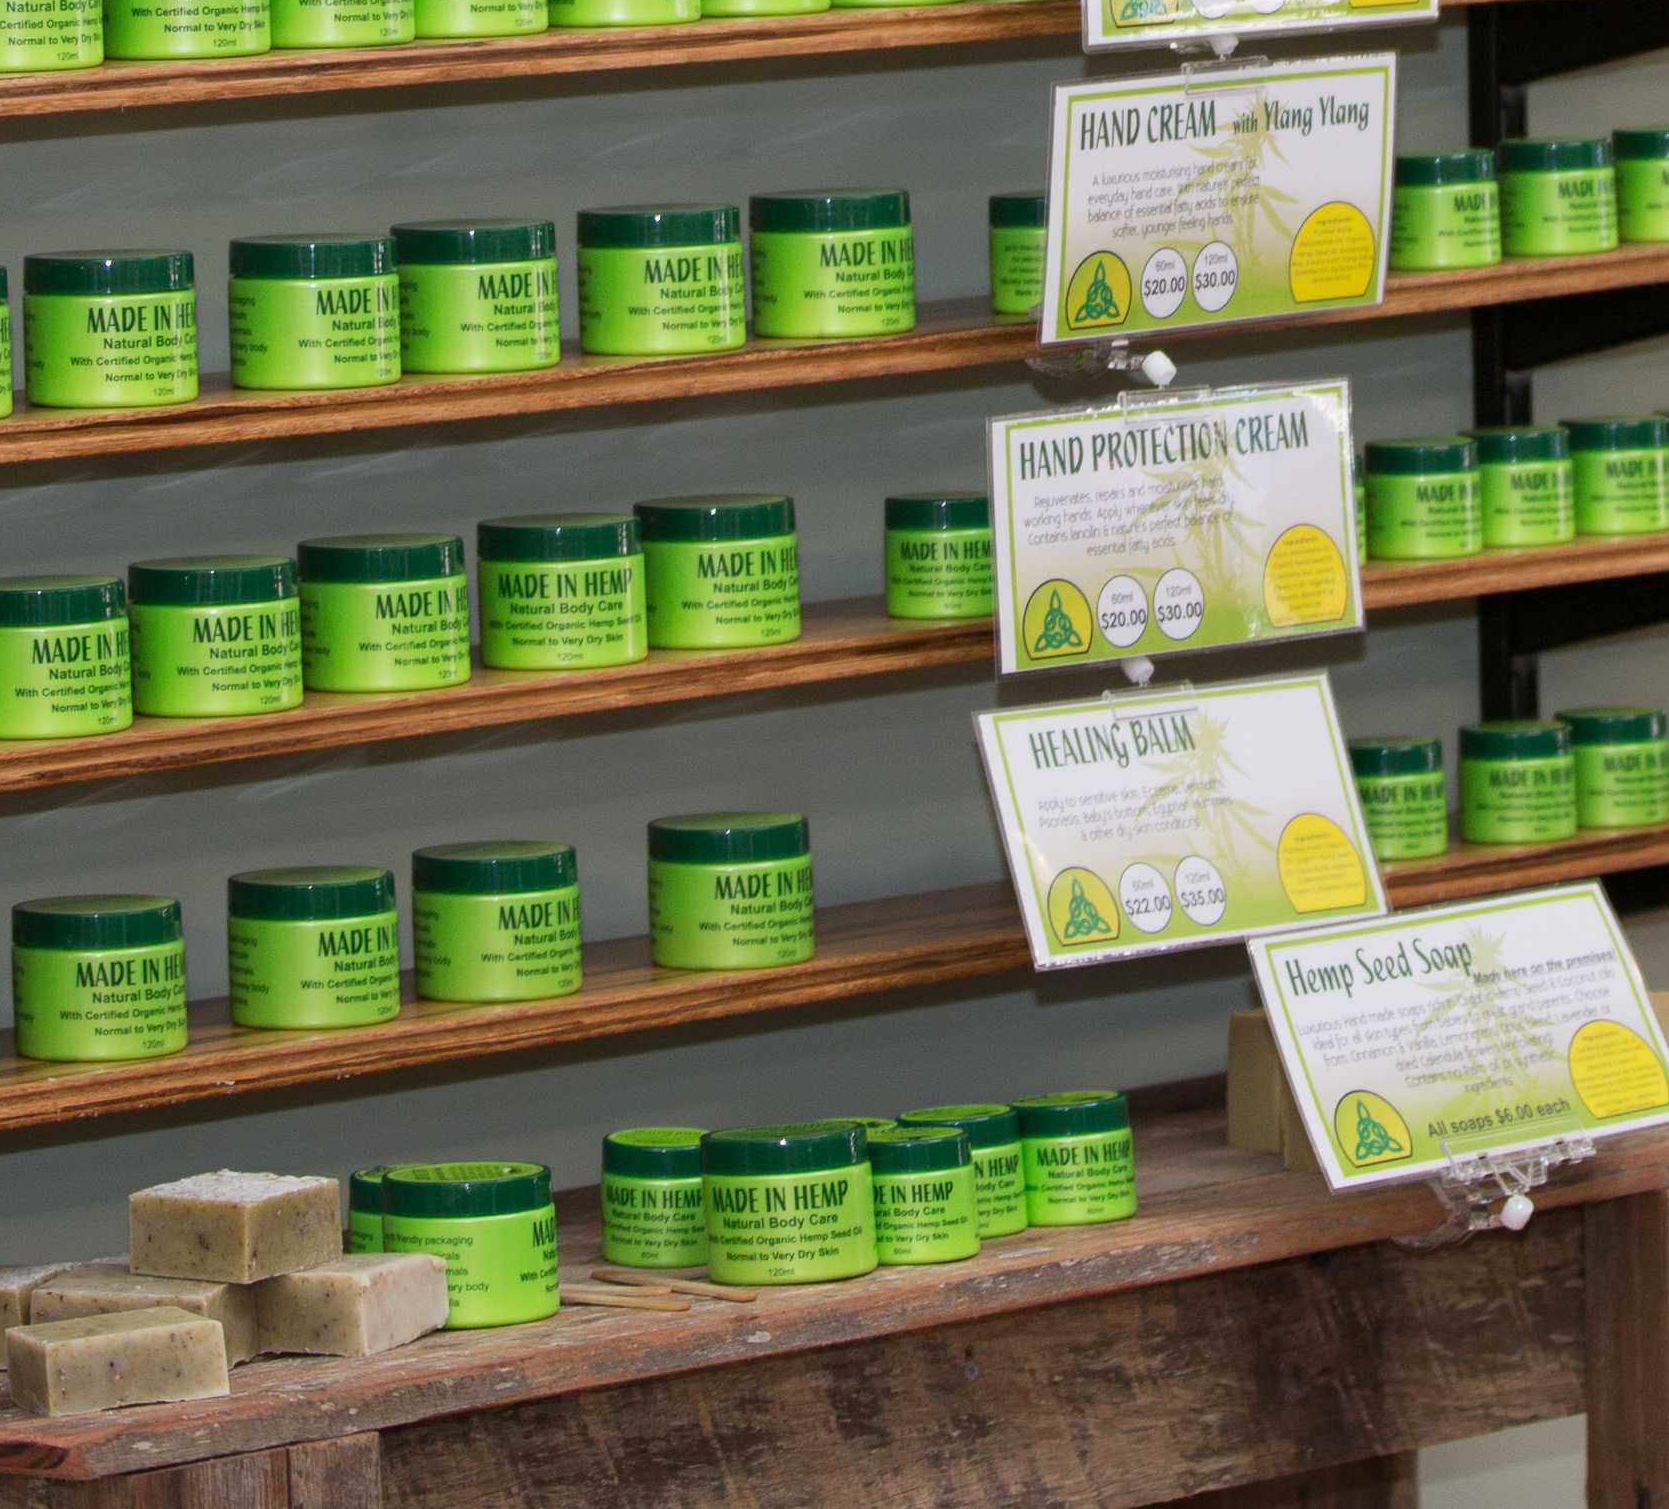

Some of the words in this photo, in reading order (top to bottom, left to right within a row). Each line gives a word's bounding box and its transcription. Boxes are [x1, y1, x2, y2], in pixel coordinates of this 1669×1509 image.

[1080, 108, 1140, 150] HAND
[1147, 101, 1215, 141] CREAM
[1232, 116, 1258, 135] with
[1263, 102, 1312, 136] Ylang
[1319, 97, 1369, 130] Ylang
[1144, 277, 1185, 296] $20.00
[1195, 272, 1235, 290] $30.00
[1020, 437, 1083, 480] HAND
[1092, 420, 1228, 471] PROTECTION
[1235, 412, 1308, 454] CREAM
[498, 573, 549, 599] MADE
[557, 574, 577, 598] IN
[585, 568, 632, 596] HEMP
[510, 603, 555, 614] Natural
[560, 602, 594, 615] Body
[598, 600, 623, 611] Care
[1101, 609, 1147, 629] $20.00
[1158, 602, 1202, 621] $30.00
[1029, 720, 1130, 769] HEALING
[1131, 715, 1196, 757] BALM
[1125, 896, 1171, 916] $22.00
[1180, 889, 1225, 908] $35.00
[1285, 959, 1353, 998] Hemp
[1355, 942, 1413, 985] Seed
[1412, 938, 1472, 976] Soap
[1504, 965, 1527, 979] here
[1530, 963, 1544, 975] on
[1546, 958, 1562, 972] the
[1428, 1121, 1447, 1137] All
[1449, 1114, 1494, 1135] soaps
[1495, 1105, 1533, 1125] $6.00
[1536, 1098, 1571, 1116] each
[1036, 1143, 1077, 1167] MADE
[1083, 1144, 1099, 1165] IN
[713, 1187, 759, 1213] MADE
[765, 1187, 786, 1212] IN
[794, 1180, 848, 1210] HEMP
[723, 1217, 764, 1229] Natural
[769, 1216, 804, 1230] Body
[809, 1213, 838, 1225] Care
[757, 1235, 796, 1246] Organic
[800, 1233, 829, 1245] Hemp
[830, 1230, 851, 1240] Seed
[760, 1252, 768, 1261] to
[772, 1250, 795, 1262] Very
[797, 1248, 816, 1260] Dry
[818, 1247, 839, 1257] Skin
